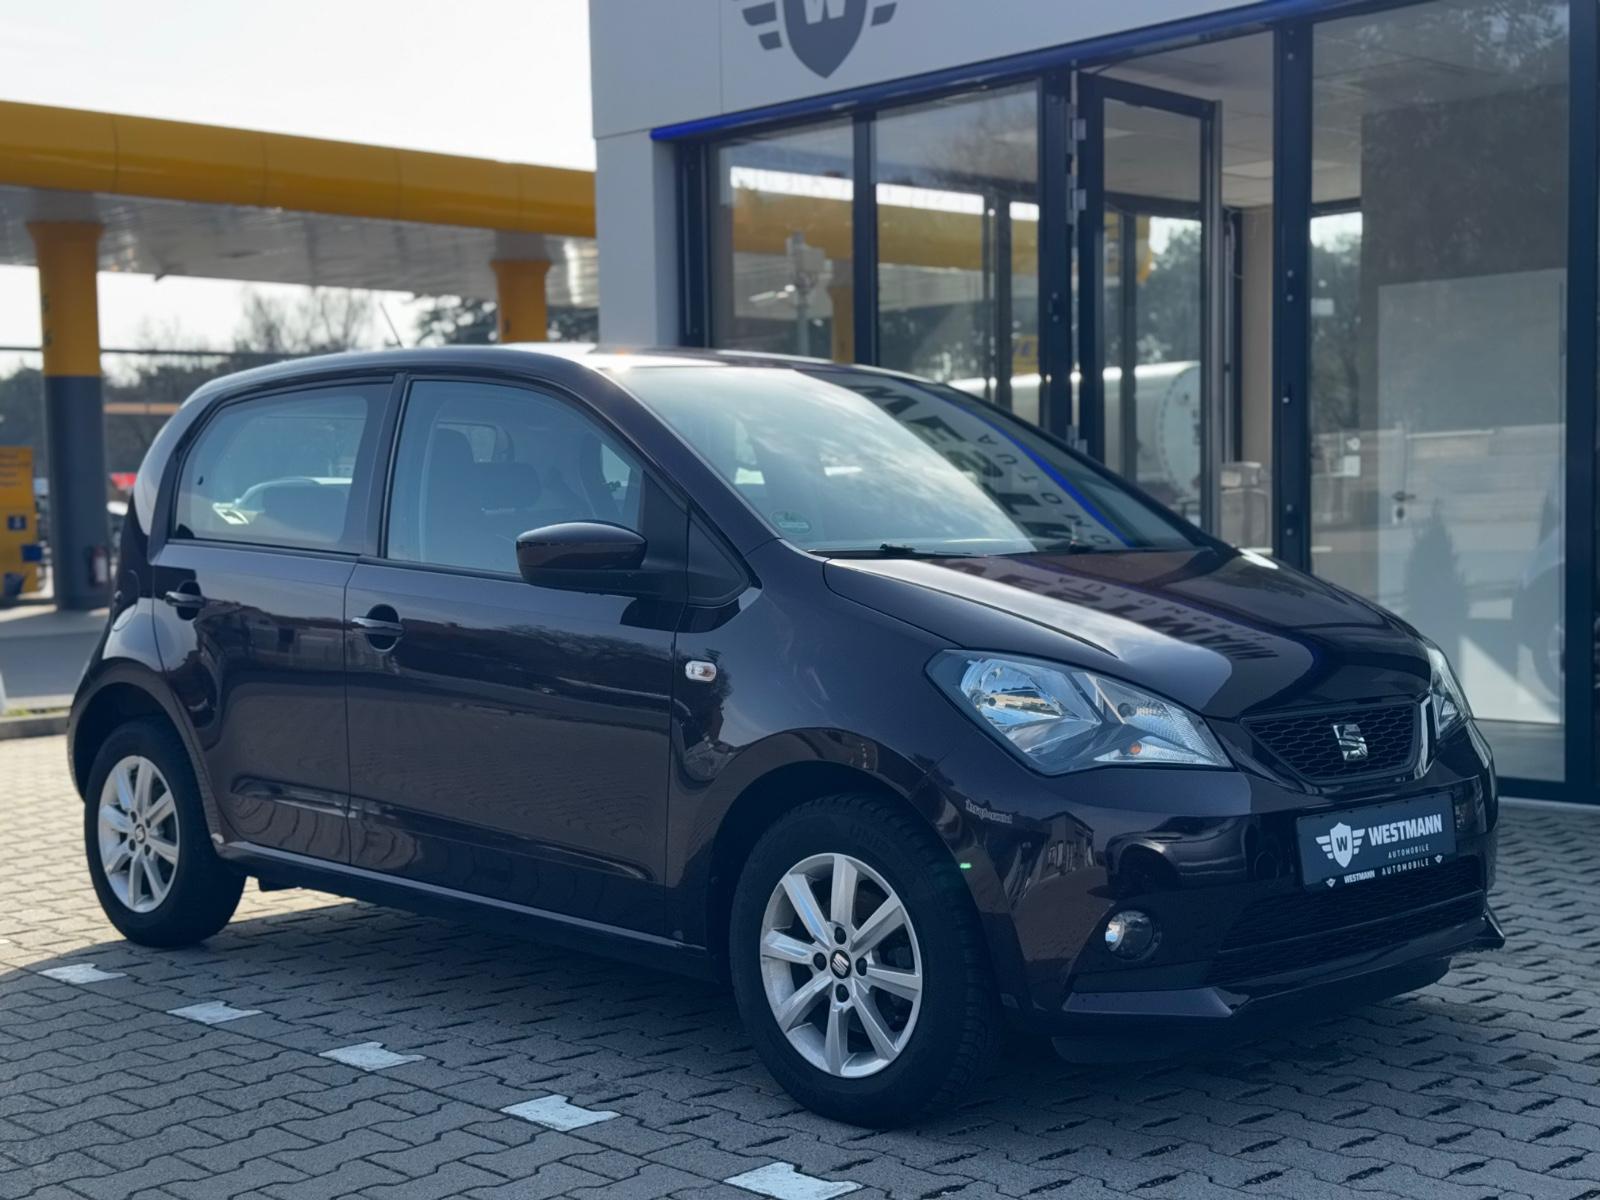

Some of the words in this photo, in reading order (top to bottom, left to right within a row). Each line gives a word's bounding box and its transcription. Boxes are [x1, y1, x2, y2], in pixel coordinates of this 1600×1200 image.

[1368, 814, 1443, 847] WESTMANN
[1336, 835, 1348, 853] W
[1388, 843, 1430, 859] AUTOMOBILE
[1344, 870, 1376, 884] WESTMANN
[1382, 858, 1430, 876] AUTOMOBILE
